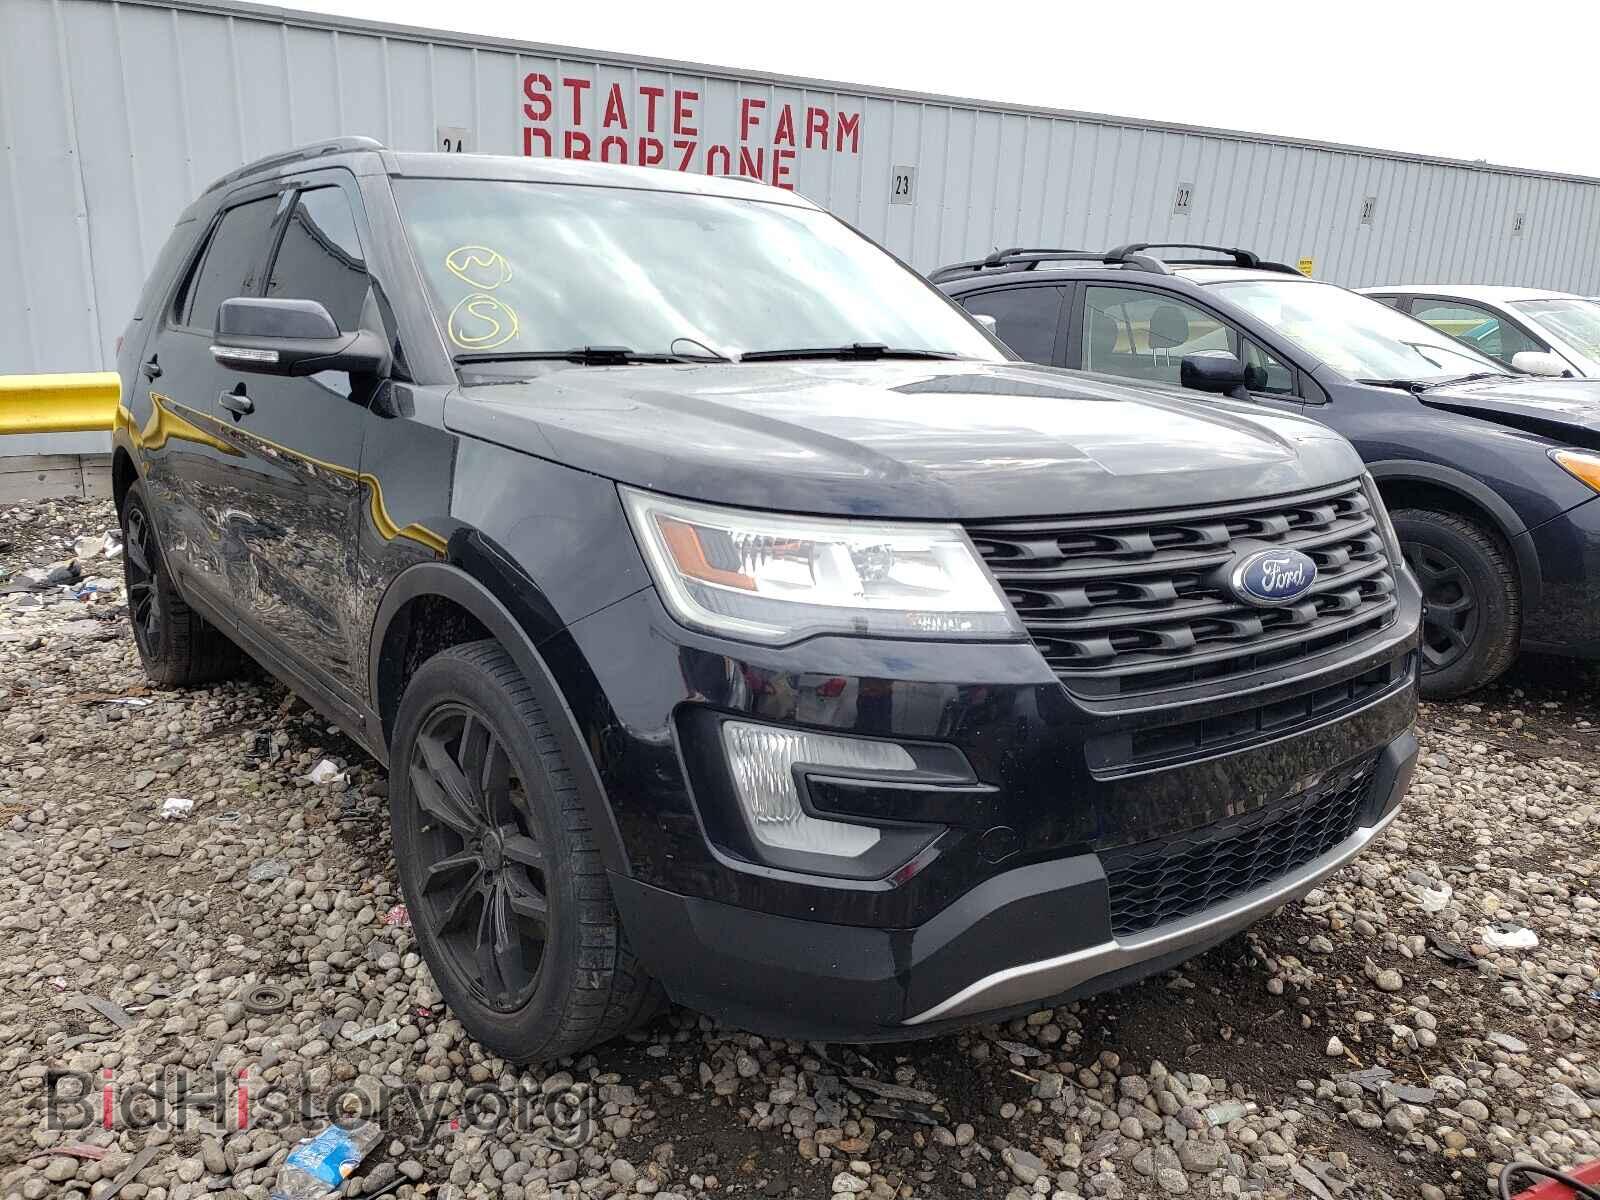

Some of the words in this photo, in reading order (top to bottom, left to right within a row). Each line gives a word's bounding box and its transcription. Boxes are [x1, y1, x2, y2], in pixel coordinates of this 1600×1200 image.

[523, 73, 698, 136] STATE
[740, 98, 859, 153] FARM
[523, 127, 796, 191] DROPZONE
[895, 175, 909, 195] 23
[1177, 189, 1190, 207] 22
[1261, 558, 1305, 592] Ford
